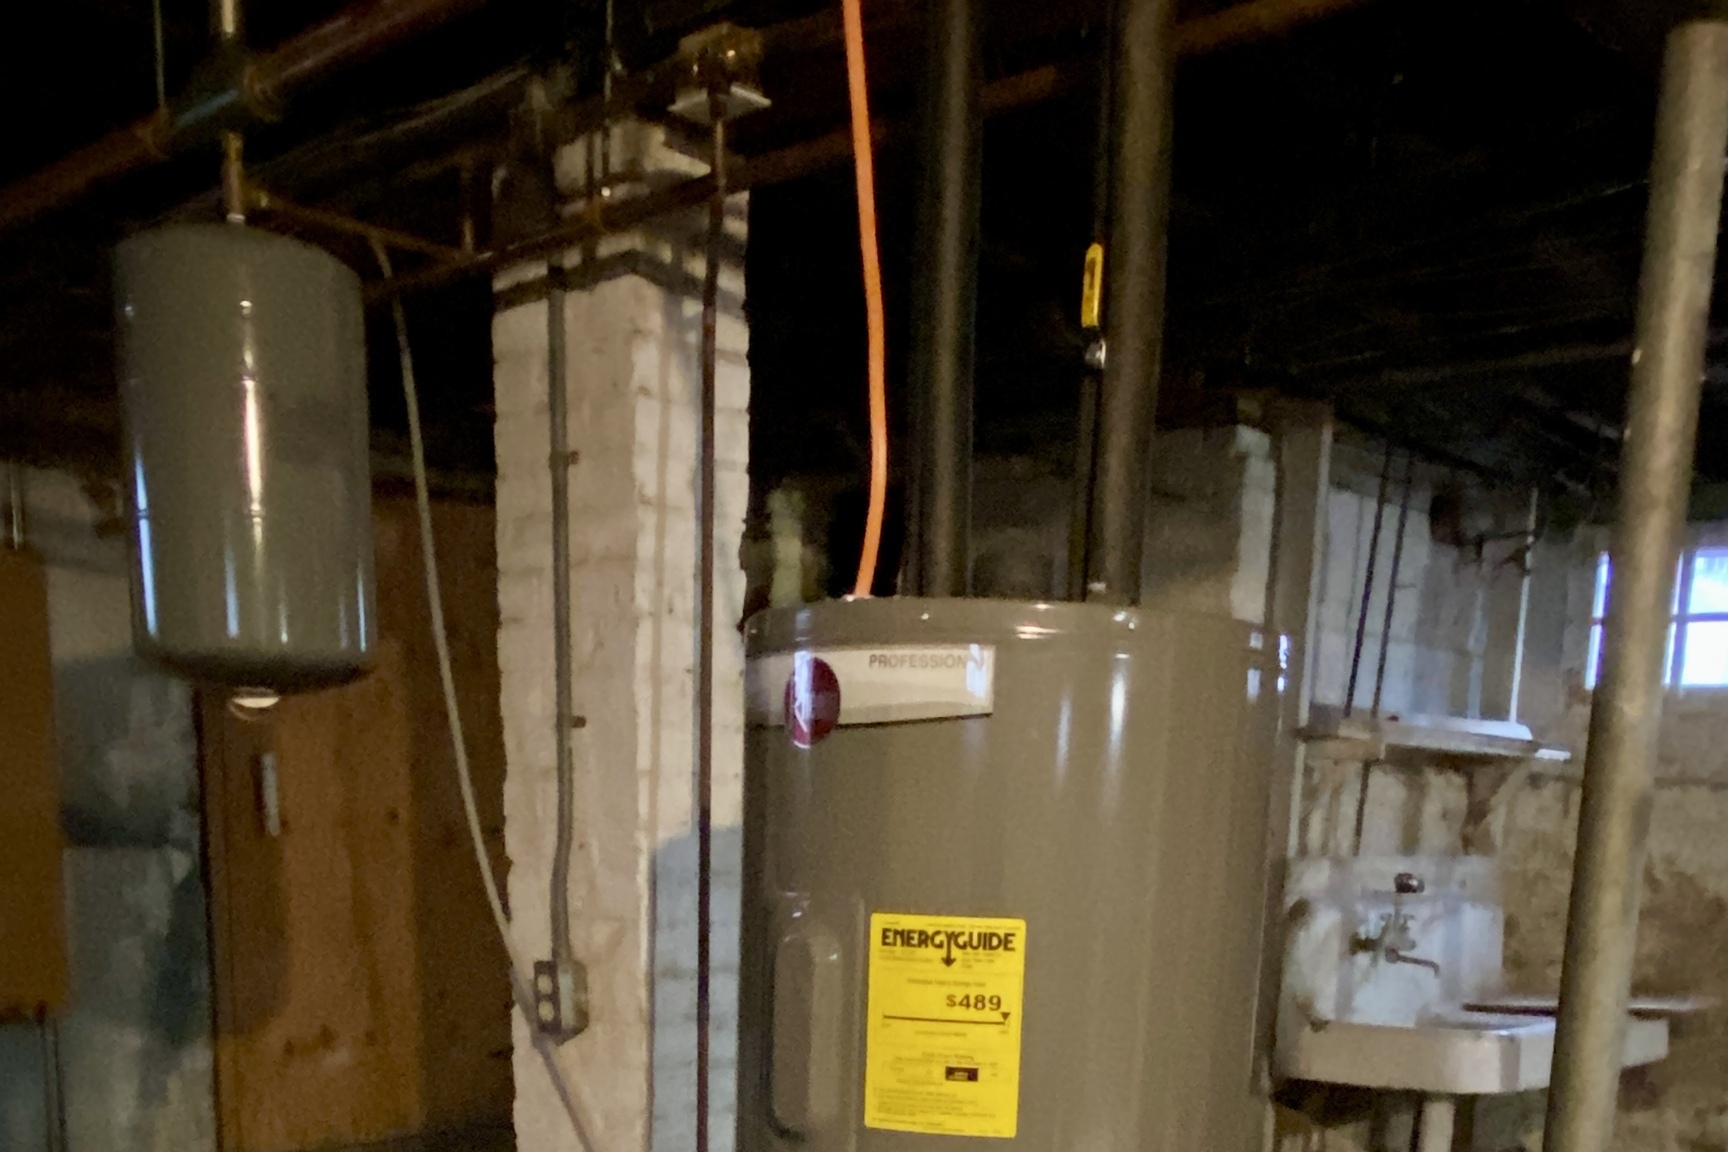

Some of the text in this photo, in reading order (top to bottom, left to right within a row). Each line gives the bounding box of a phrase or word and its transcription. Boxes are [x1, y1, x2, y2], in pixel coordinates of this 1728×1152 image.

[868, 653, 985, 670] PROFESSION
[881, 927, 1016, 952] ENERGYGUIDE
[945, 993, 1002, 1012] $489
